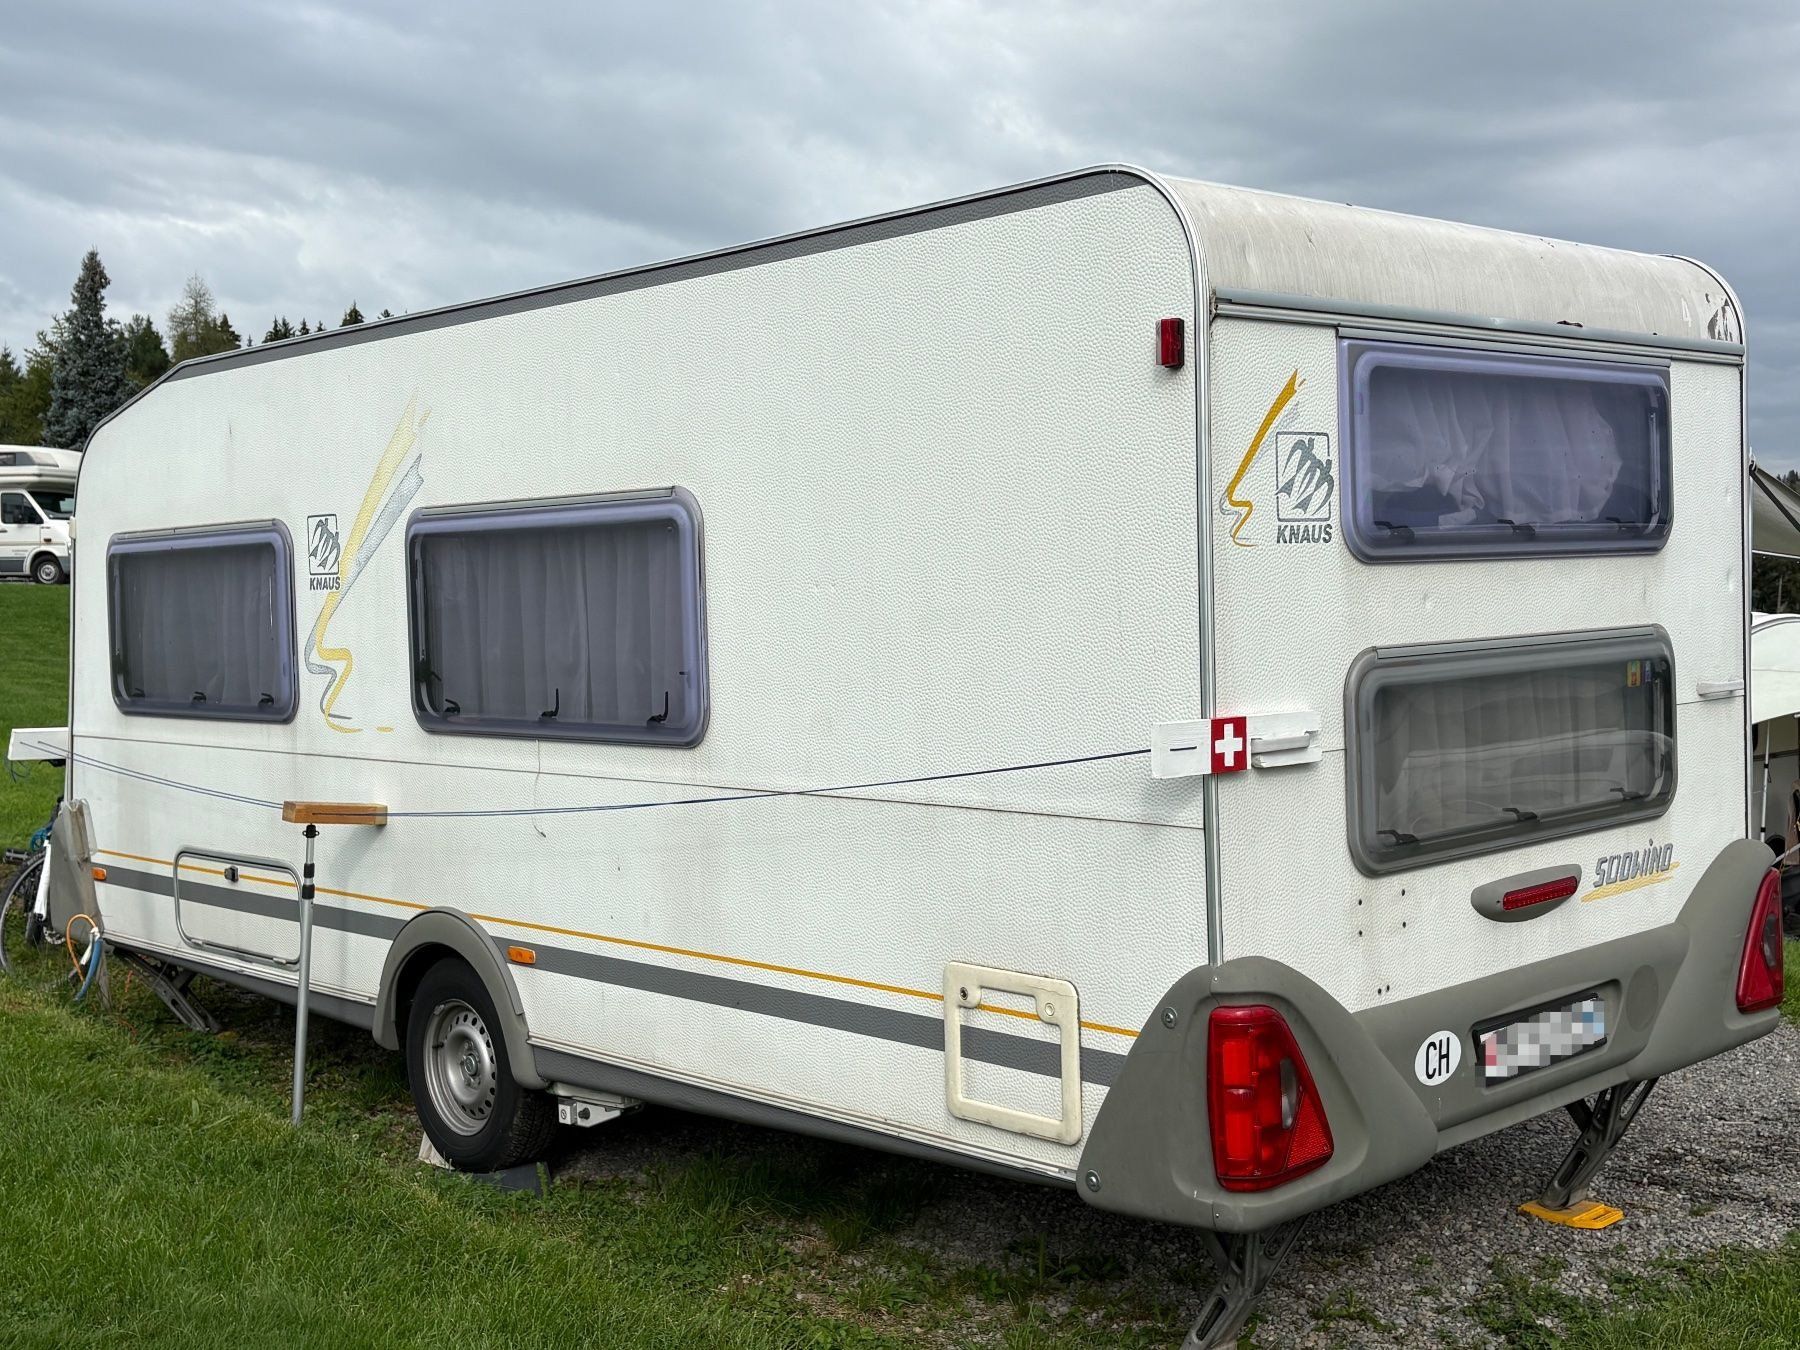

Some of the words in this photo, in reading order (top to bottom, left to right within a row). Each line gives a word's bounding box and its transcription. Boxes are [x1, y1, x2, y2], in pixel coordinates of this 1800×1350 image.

[1277, 523, 1333, 544] KNAUS
[309, 576, 341, 591] KNAUS
[1425, 1037, 1450, 1080] CH
